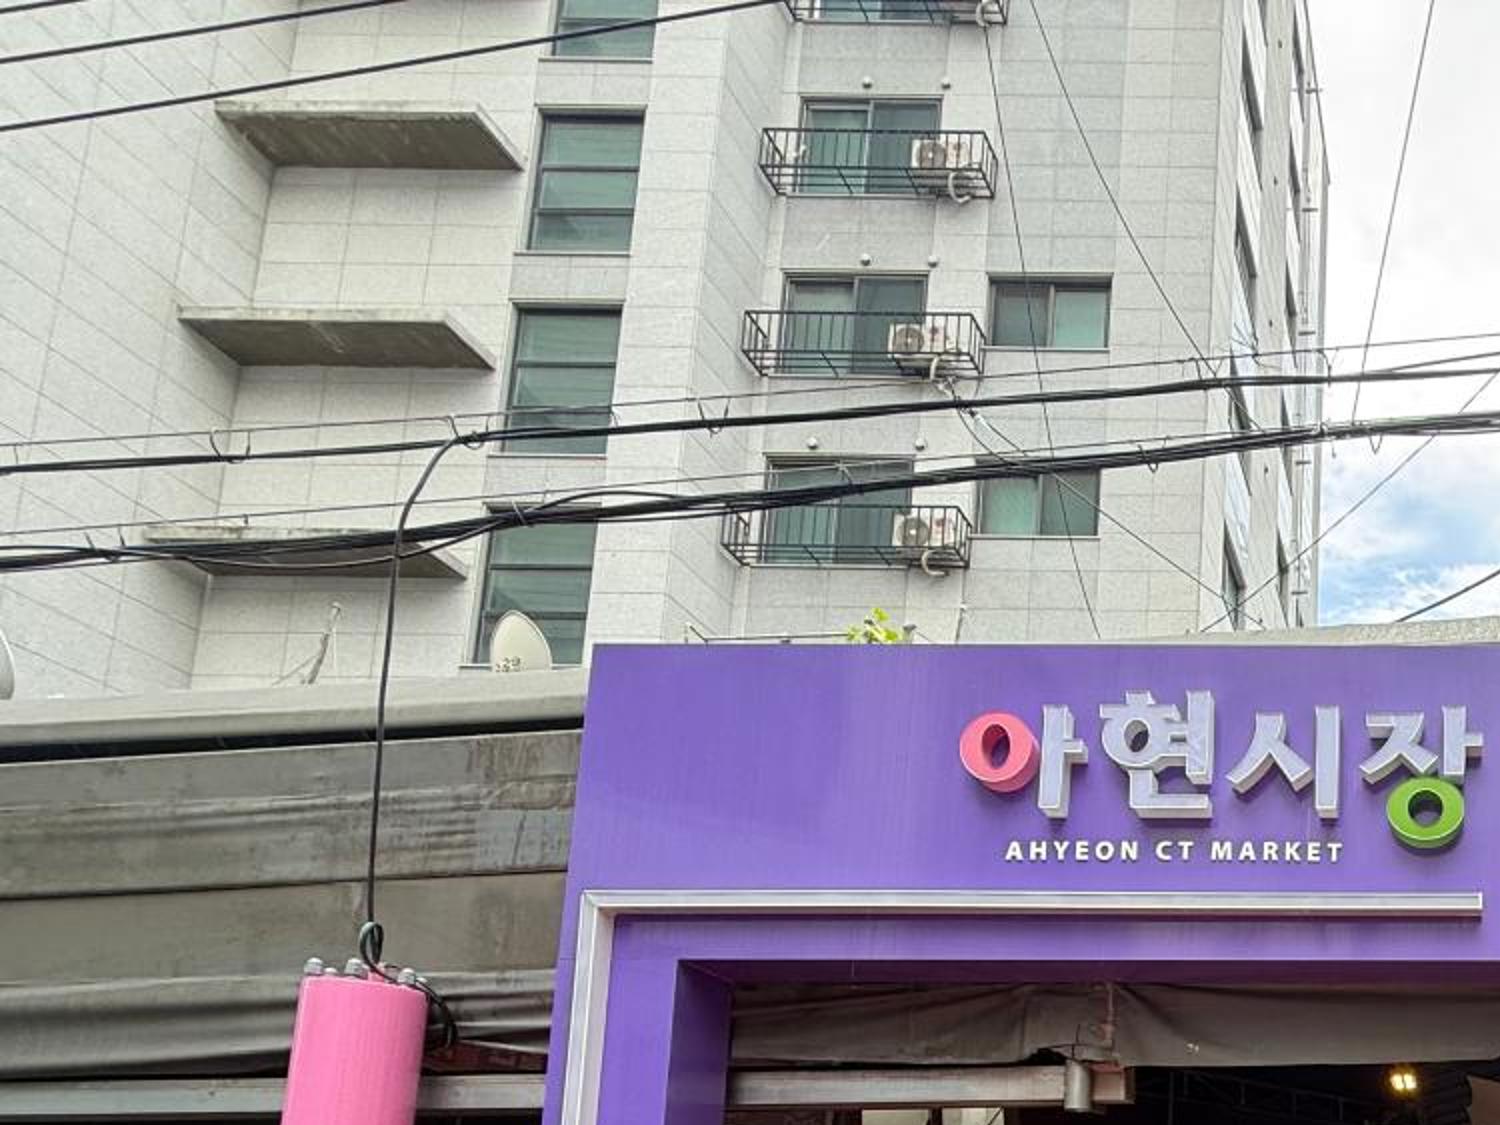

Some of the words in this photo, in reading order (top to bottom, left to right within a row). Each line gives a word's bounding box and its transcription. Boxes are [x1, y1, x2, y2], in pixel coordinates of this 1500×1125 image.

[960, 690, 1483, 849] 아현시장
[1005, 840, 1140, 862] AHYEON
[1155, 841, 1194, 861] CT
[1211, 841, 1344, 863] MARKET
